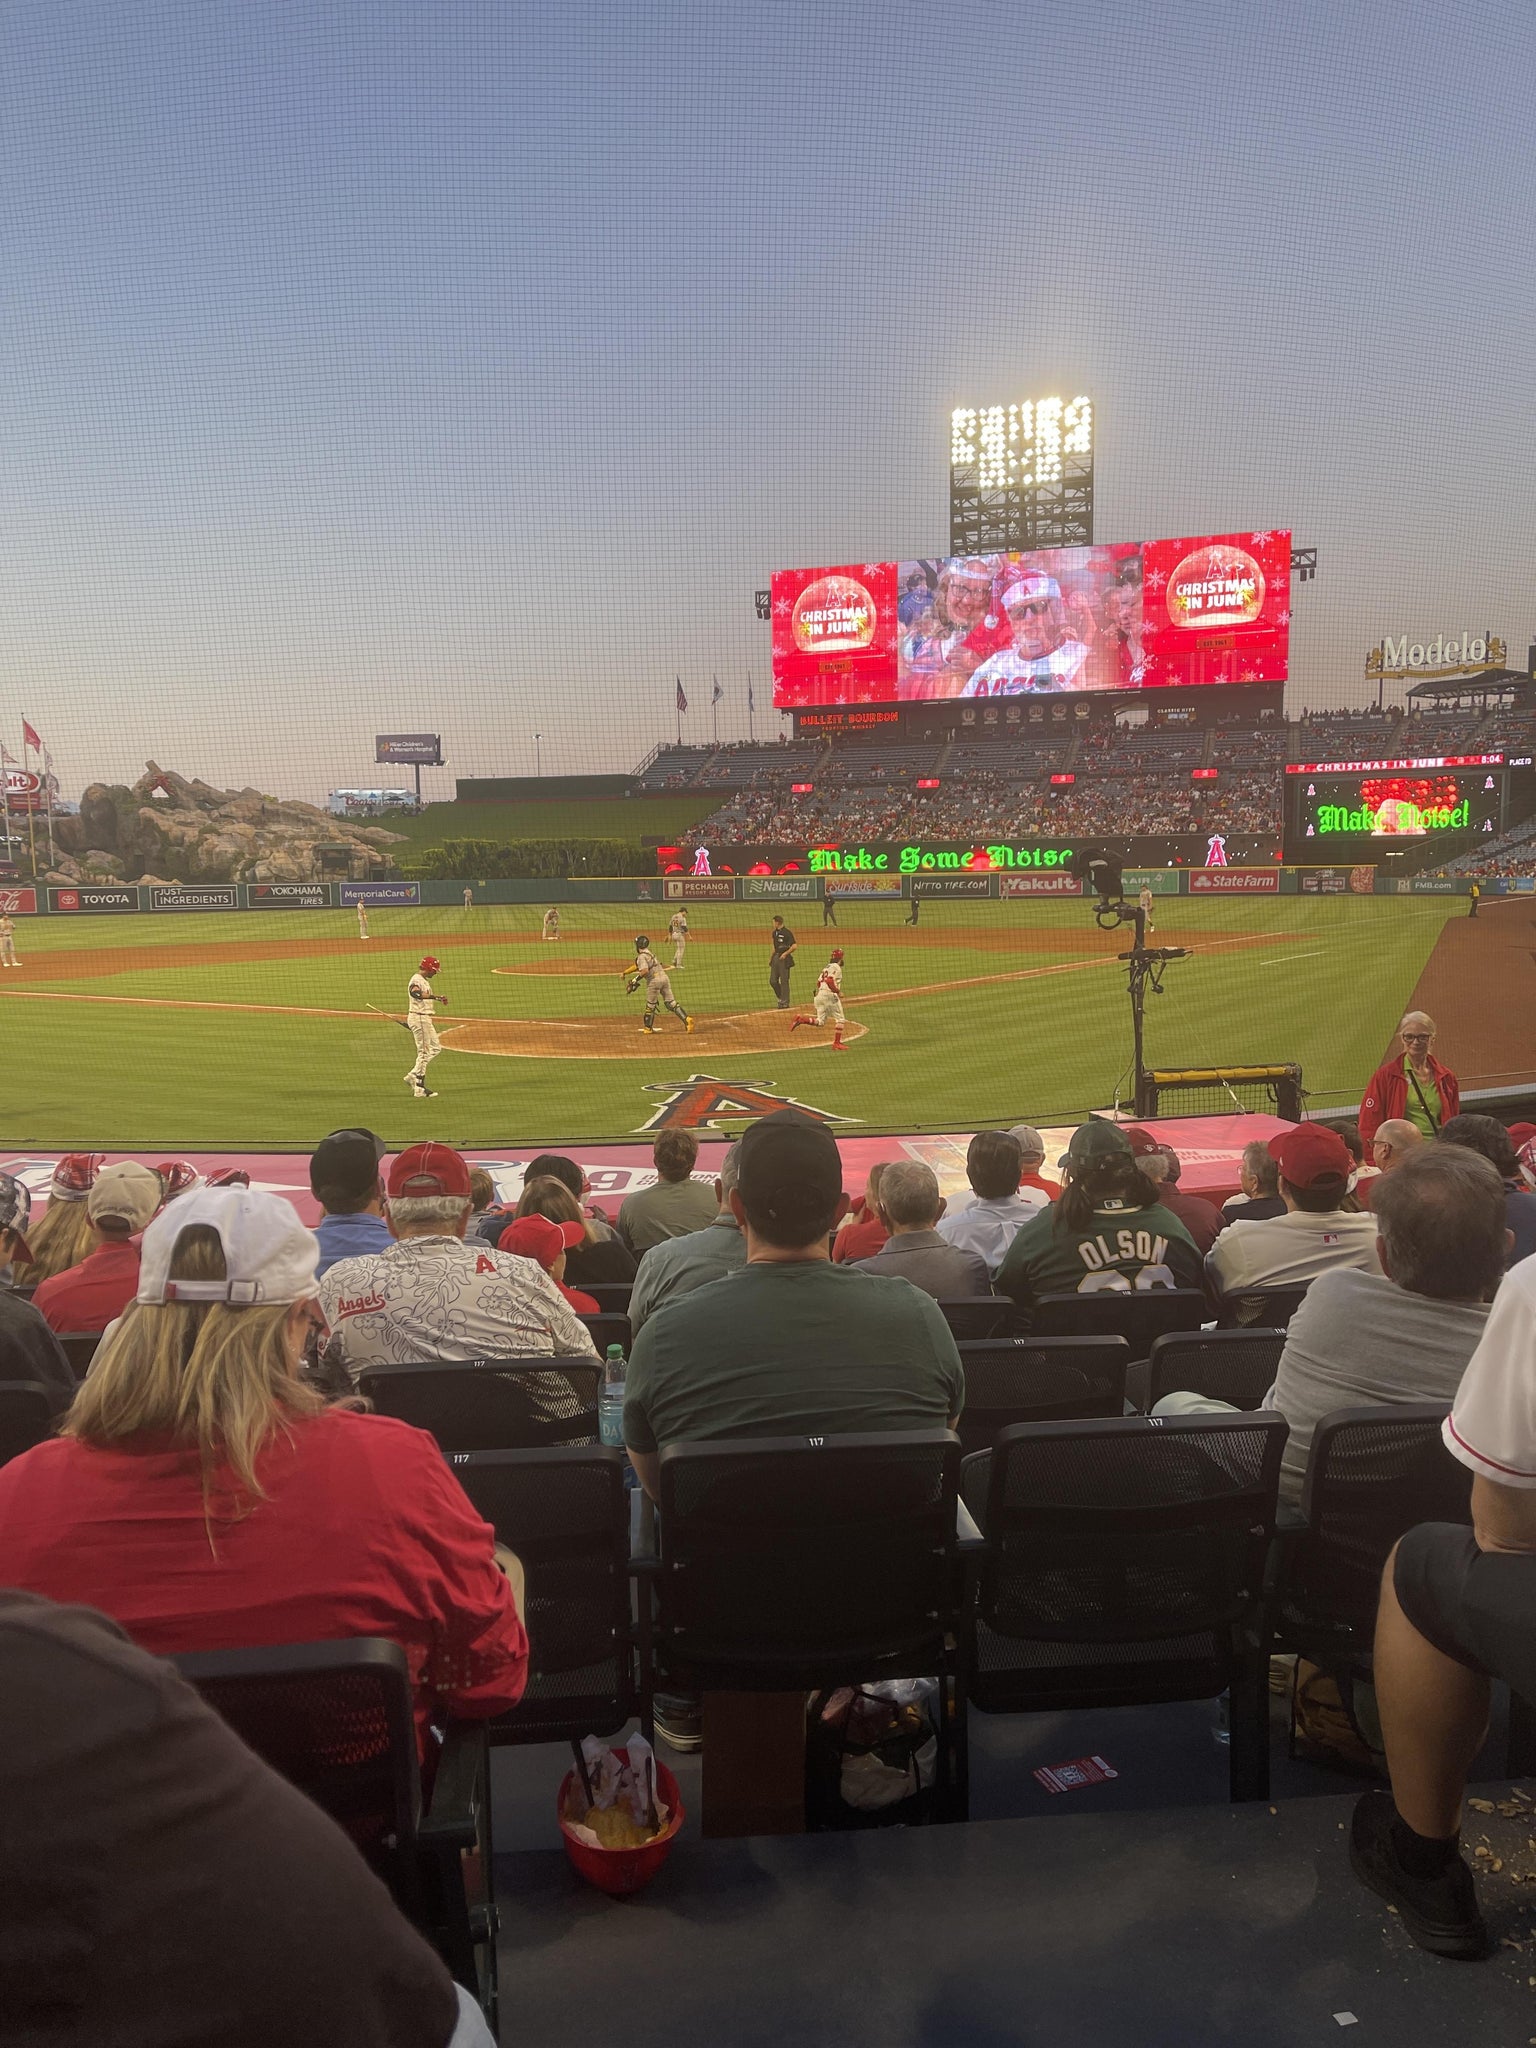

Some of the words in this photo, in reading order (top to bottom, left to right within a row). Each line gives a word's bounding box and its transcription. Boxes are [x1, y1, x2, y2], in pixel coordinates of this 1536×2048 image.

[1175, 577, 1256, 596] CHRISTMAS
[1186, 596, 1203, 609] IN
[1207, 593, 1244, 608] JUNE
[800, 607, 868, 622] CHRISTMAS
[809, 623, 823, 635] IN
[826, 621, 859, 634] JUNE
[1384, 631, 1486, 668] Modelo
[800, 714, 844, 725] BULLEIT
[848, 712, 898, 724] BOURBON
[1316, 761, 1388, 773] CHRISTMAS
[1393, 760, 1407, 769] IN
[1412, 757, 1444, 768] JUNE
[1317, 803, 1388, 834] Make
[1395, 799, 1470, 829] Noise!
[808, 847, 888, 873] Make
[899, 845, 974, 873] Some
[685, 883, 729, 891] PECHANGA
[763, 880, 809, 891] National
[830, 880, 873, 894] Surfside
[914, 881, 941, 890] NITTO
[1008, 877, 1077, 890] Yakult
[1415, 881, 1451, 889] FMB.com
[159, 888, 182, 896] JUST
[271, 886, 323, 896] YOKOHAMA
[344, 889, 405, 899] MemorialCare
[82, 894, 129, 904] TOYOTA
[160, 894, 229, 905] INGREDIENTS
[300, 897, 324, 905] TIRES
[1078, 1229, 1169, 1271] OLSON
[475, 1254, 497, 1274] A
[337, 1291, 386, 1315] Angels
[1148, 1418, 1163, 1427] 117
[809, 1437, 824, 1447] 117
[453, 1454, 470, 1464] 117
